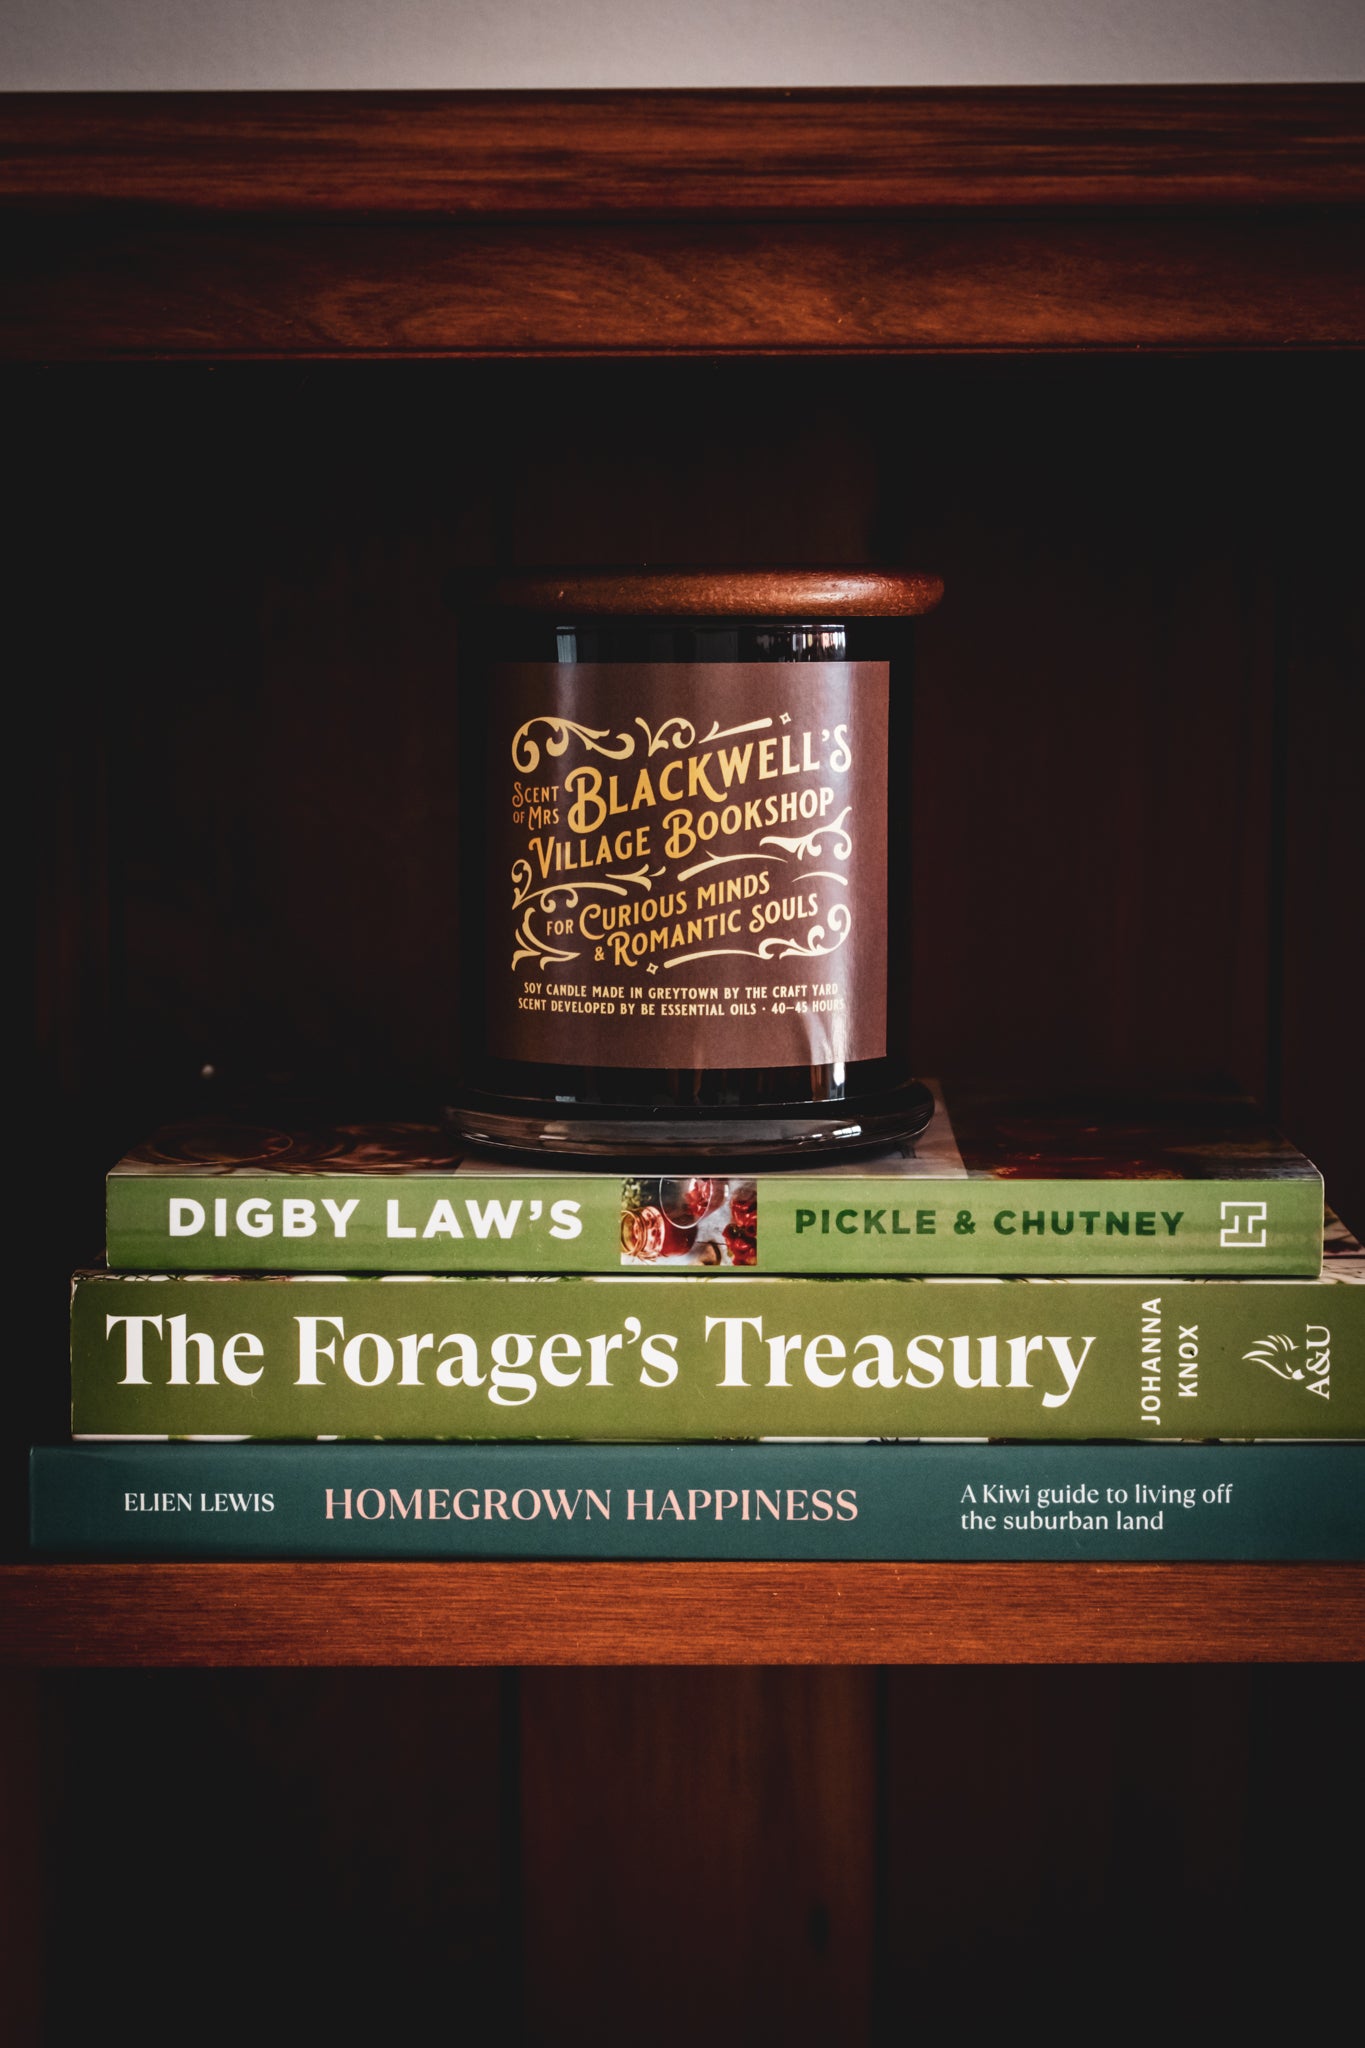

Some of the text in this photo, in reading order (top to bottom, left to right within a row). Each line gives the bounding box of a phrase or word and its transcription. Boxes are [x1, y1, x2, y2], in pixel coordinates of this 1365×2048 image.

[512, 781, 559, 807] SCENT
[564, 724, 852, 833] BLACKWELL'S
[513, 805, 559, 830] OF MRS
[529, 787, 834, 879] VILLAGE BOOKSHOP
[547, 871, 770, 940] FOR CURIOUS MINDS
[594, 893, 818, 967] & ROMANTIC SOULS
[518, 998, 547, 1011] SCENT
[551, 1000, 615, 1014] DEVELOPED
[620, 1003, 635, 1015] BY
[641, 1003, 655, 1015] BE
[661, 1003, 725, 1016] ESSENTIAL
[730, 1003, 757, 1015] OILS
[812, 1000, 845, 1012] HOURS
[524, 982, 838, 999] SOY CANDLE MADE IN GREYTOWN BY THE CRAFT YARD
[169, 1197, 582, 1240] DIGBY LAW'S
[796, 1209, 1185, 1237] PICKLE & CHUTNEY
[106, 1314, 1096, 1408] The Forager's Treasury
[1141, 1297, 1162, 1425] JOHANNA
[1178, 1324, 1198, 1398] KNOX
[1305, 1324, 1331, 1399] A&U
[125, 1493, 275, 1513] ELIEN LEWIS
[325, 1487, 859, 1522] HOMEGROWN HAPPINESS
[961, 1484, 1233, 1510] A Kiwi guide to living off
[961, 1510, 1164, 1531] the suburban land
